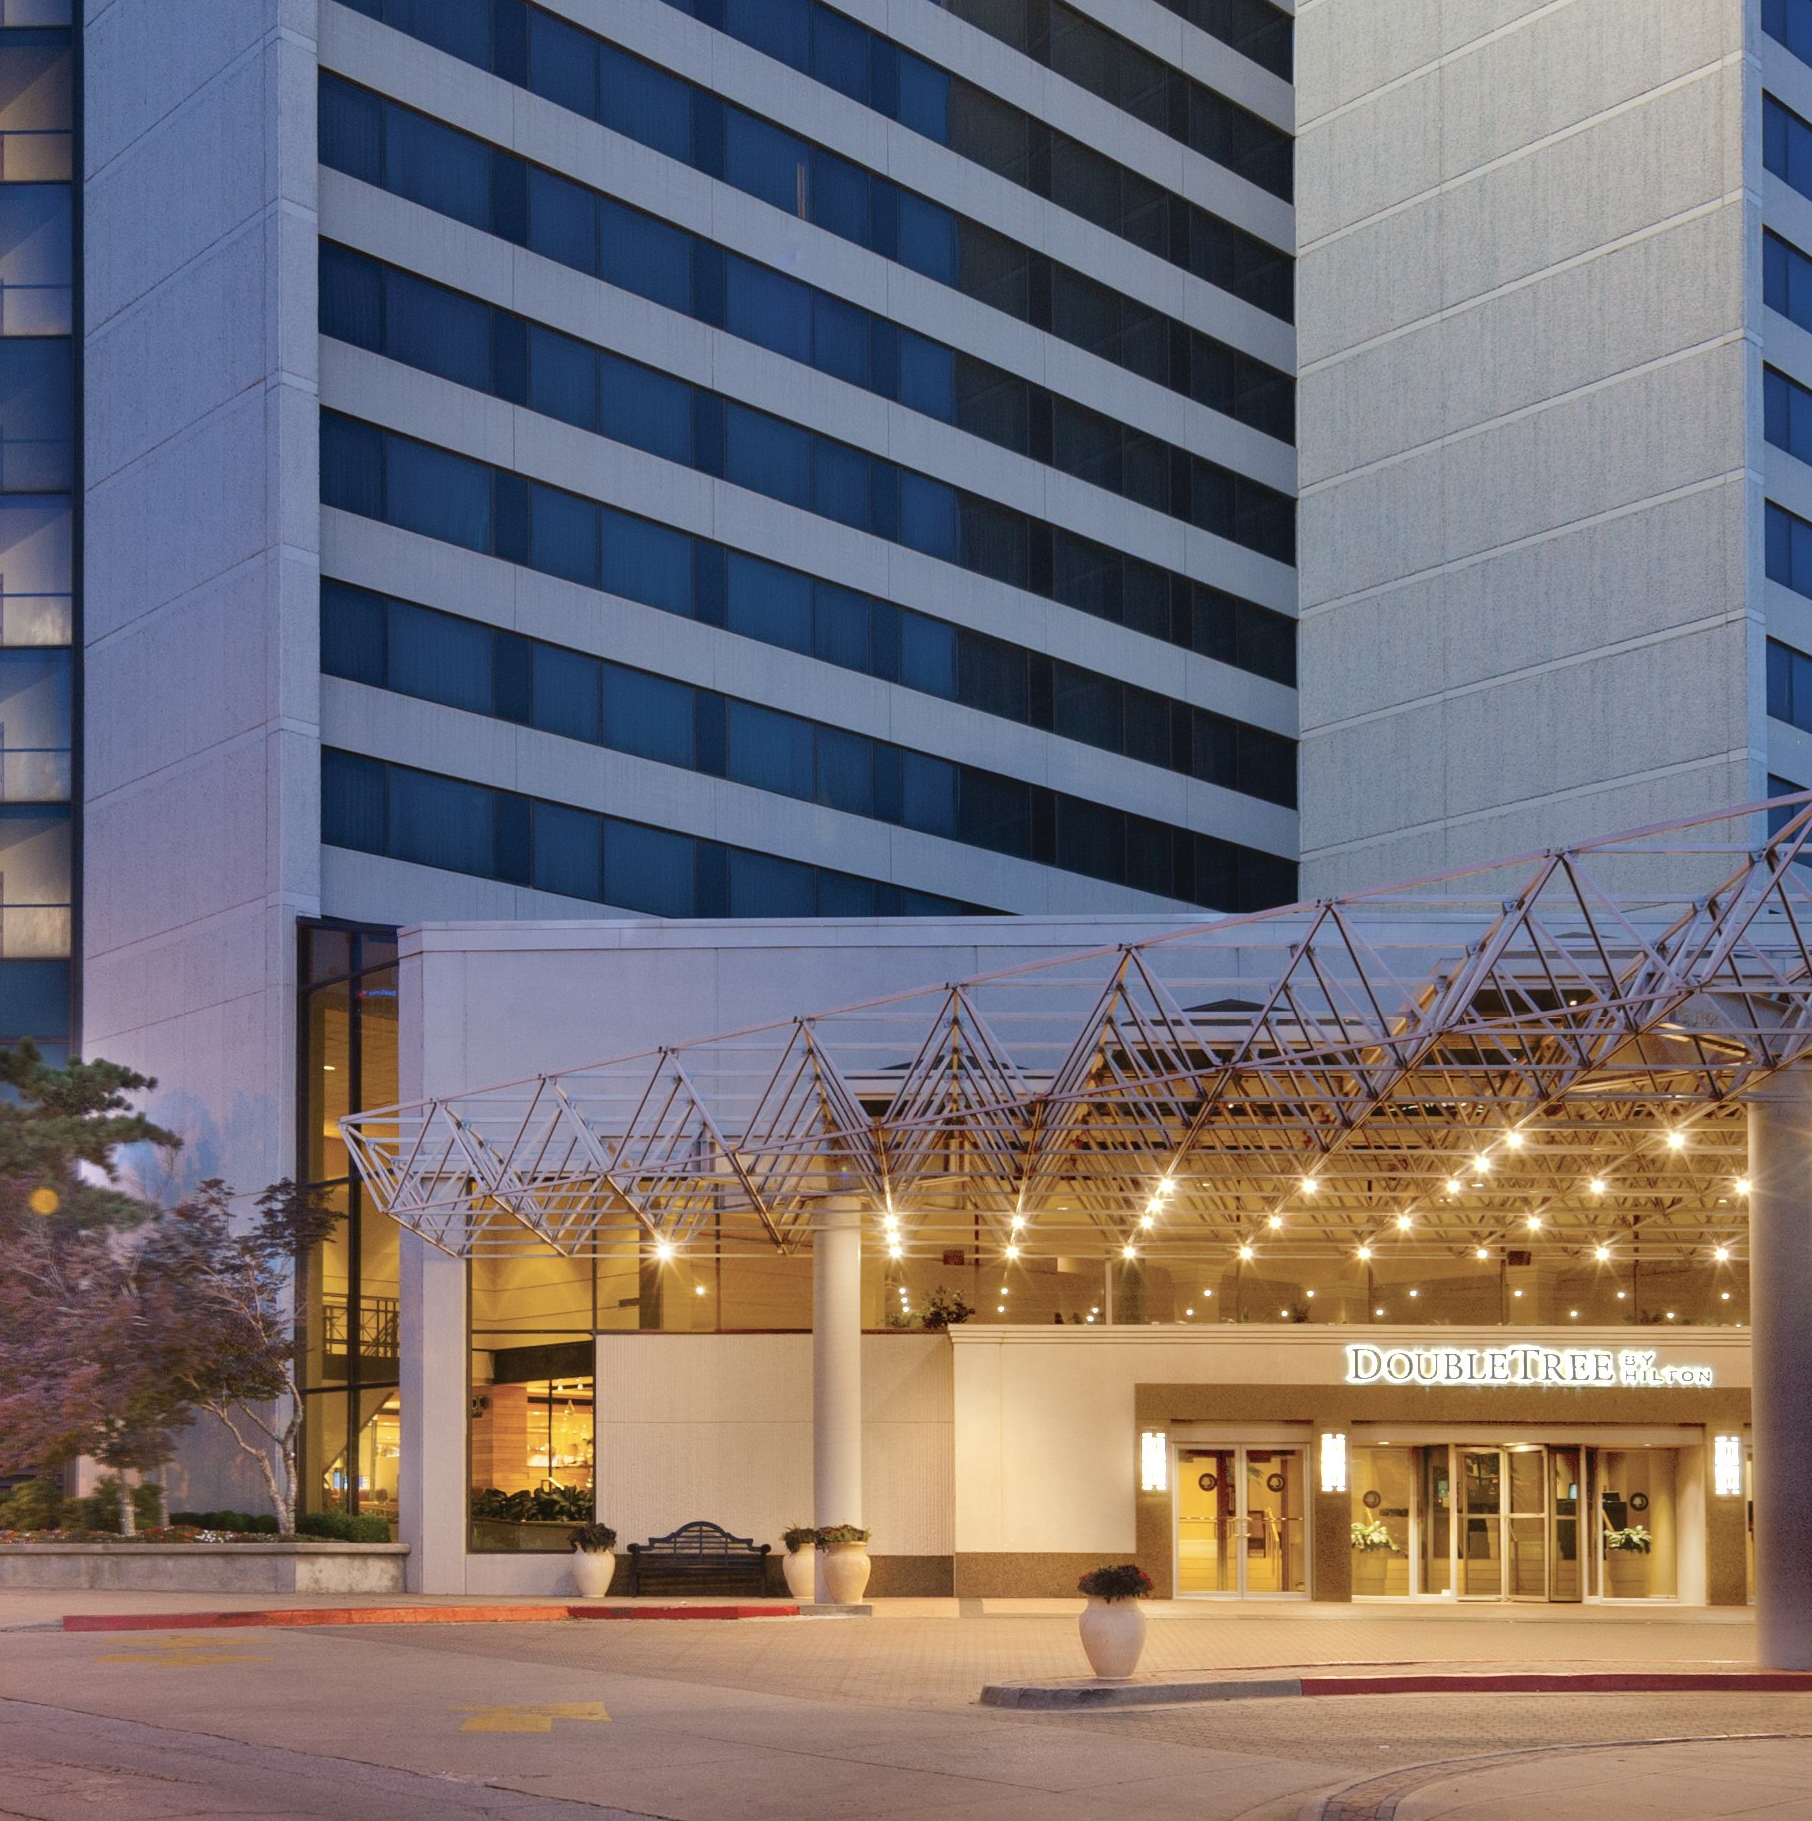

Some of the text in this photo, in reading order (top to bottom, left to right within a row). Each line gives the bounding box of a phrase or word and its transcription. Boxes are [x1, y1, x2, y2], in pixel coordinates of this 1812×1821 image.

[1351, 1347, 1615, 1381] DOUBLETREE
[1624, 1355, 1653, 1366] BY
[1624, 1370, 1711, 1382] HILTON
